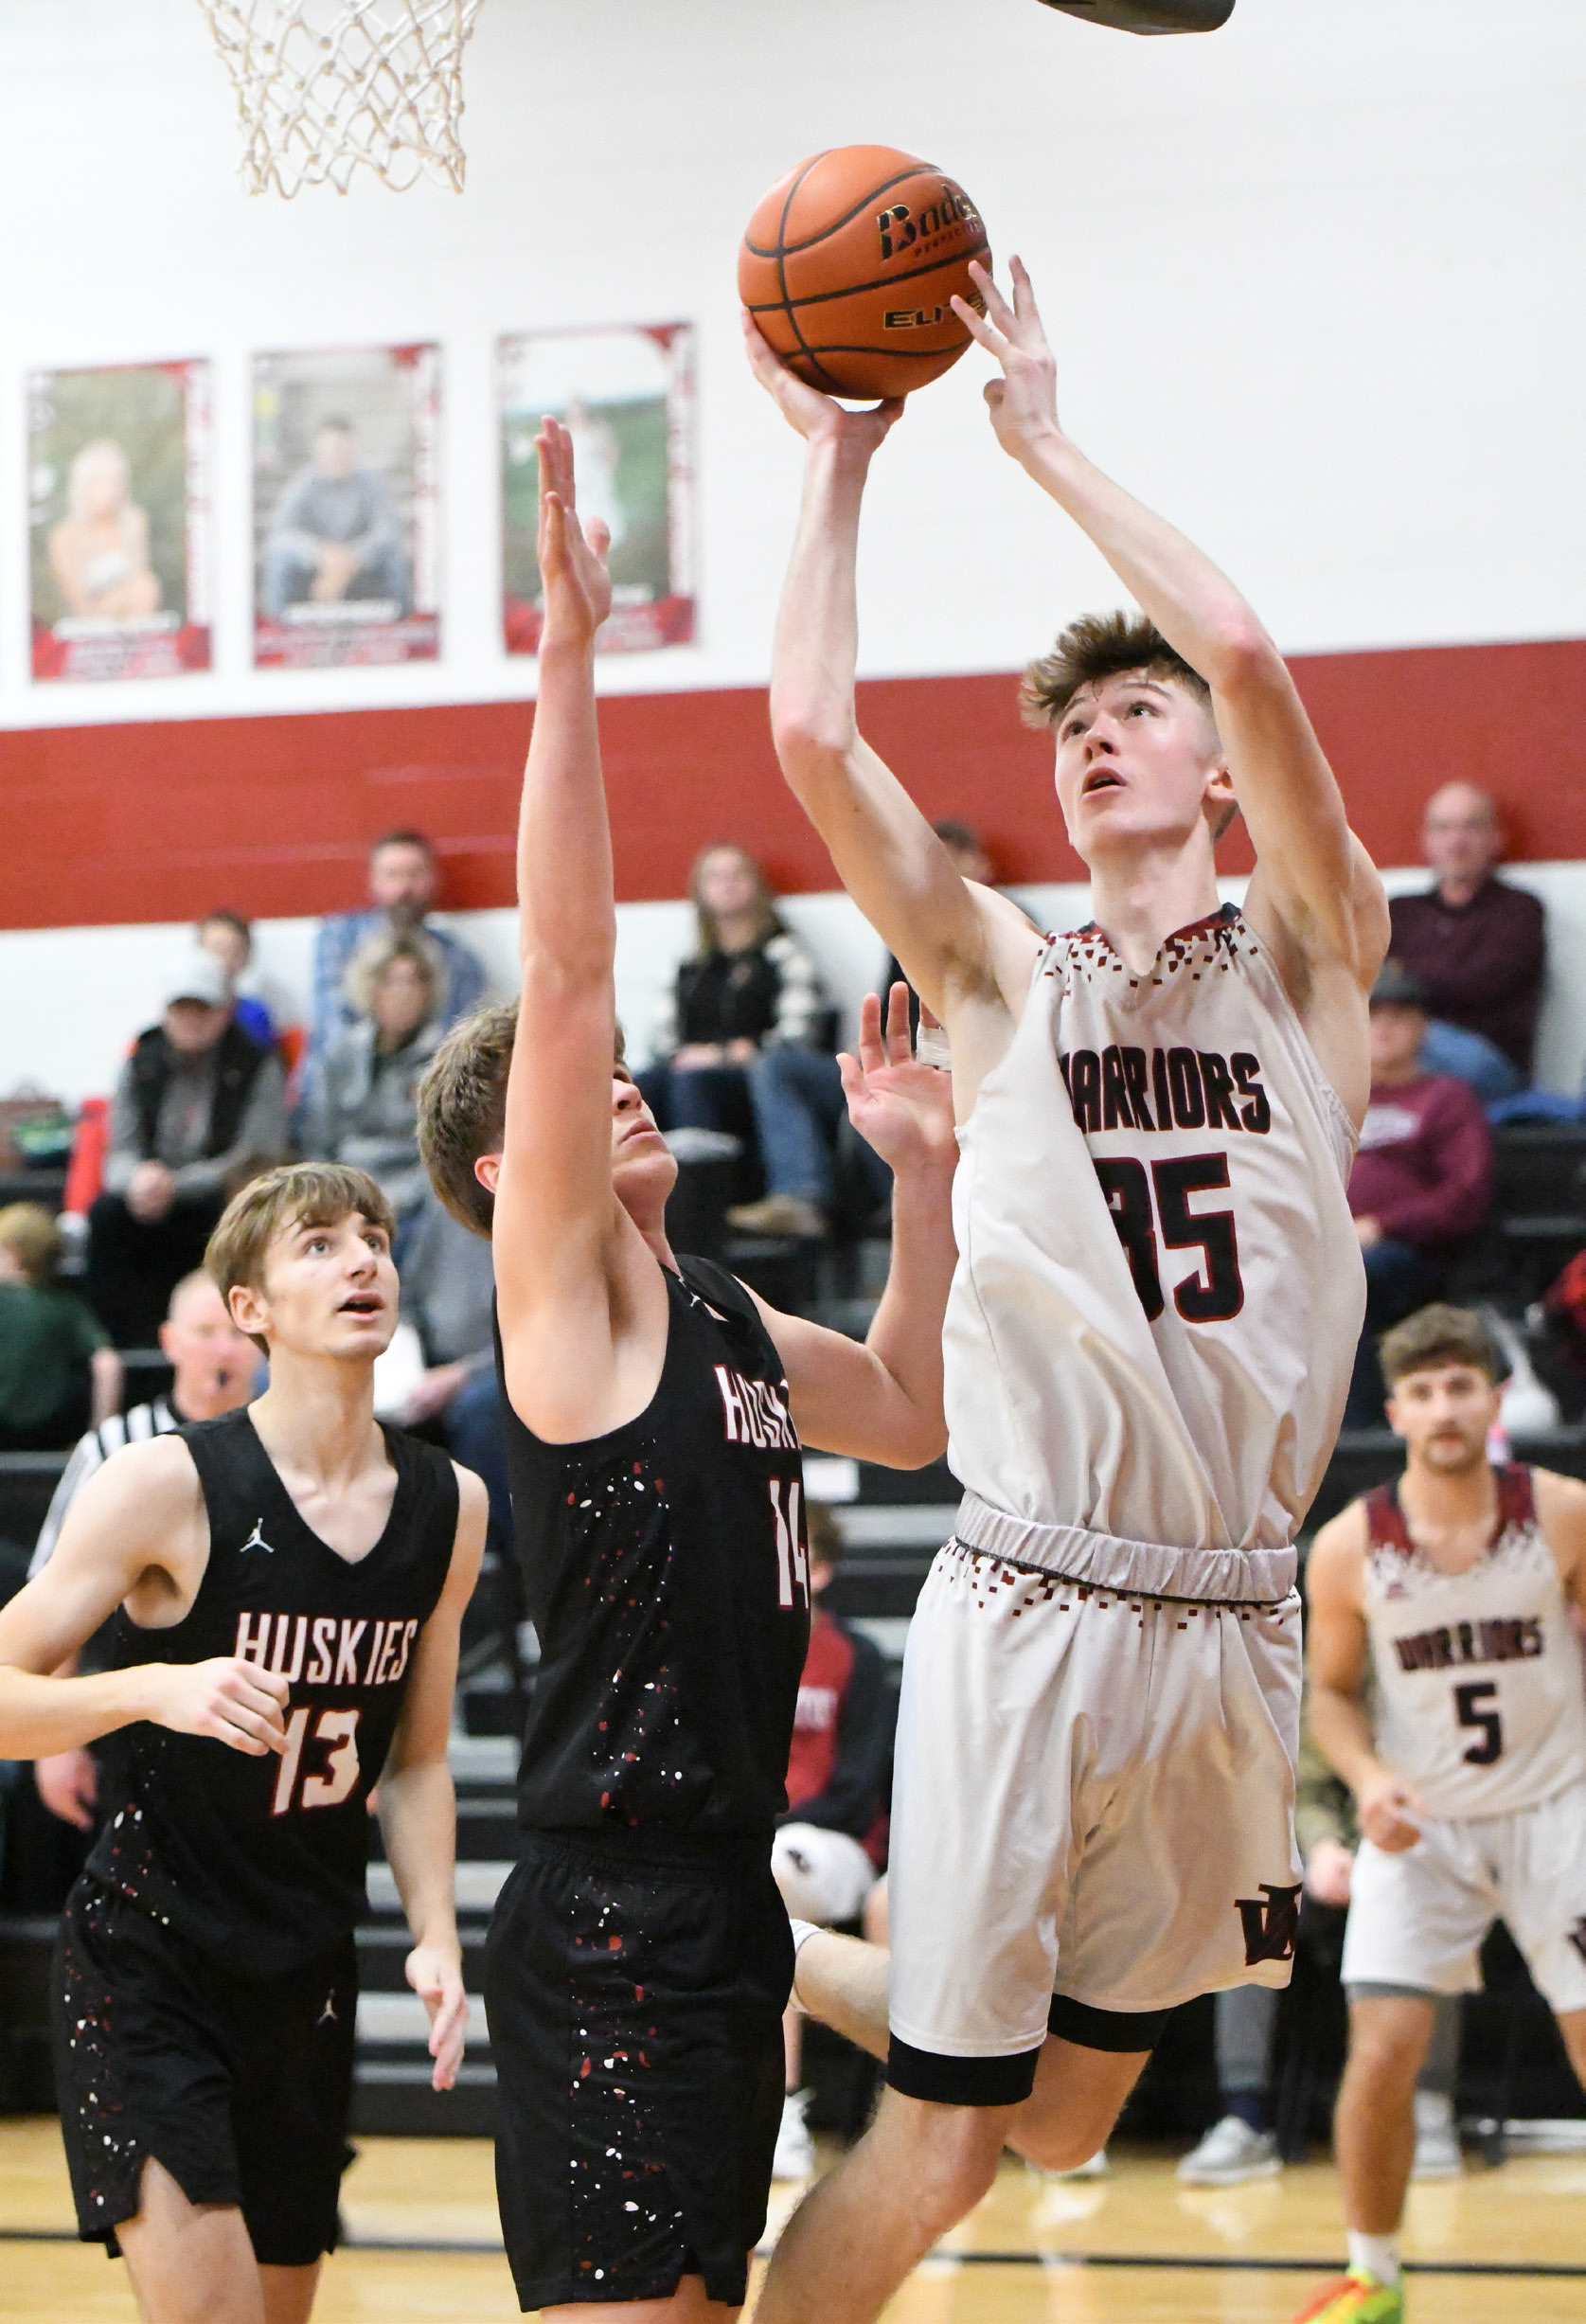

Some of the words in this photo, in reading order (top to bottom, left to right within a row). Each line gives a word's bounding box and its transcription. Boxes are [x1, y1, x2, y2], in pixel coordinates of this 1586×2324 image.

[877, 184, 979, 259] Bade
[1092, 1152, 1245, 1324] 35
[714, 1364, 802, 1450] HUSK
[769, 1475, 809, 1610] 14
[235, 1612, 419, 1686] HUSKIES
[271, 1706, 362, 1817] 13
[1453, 1680, 1504, 1765] 5
